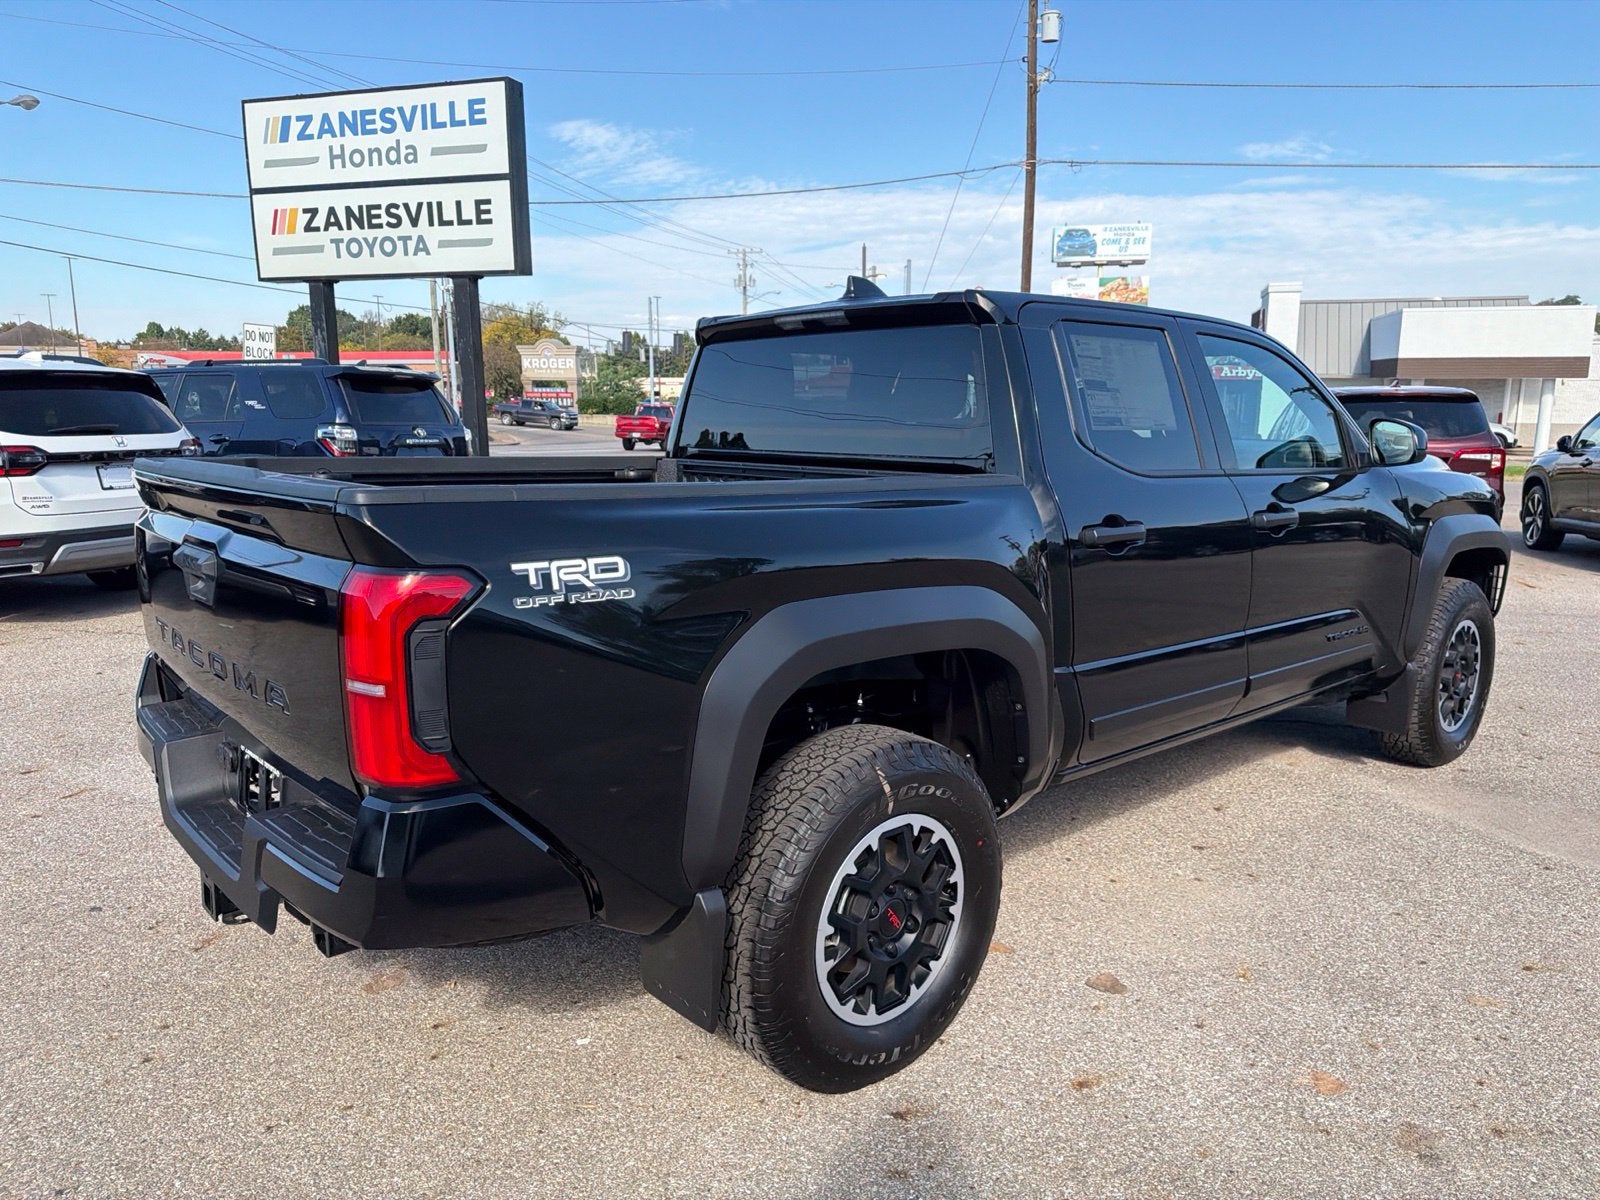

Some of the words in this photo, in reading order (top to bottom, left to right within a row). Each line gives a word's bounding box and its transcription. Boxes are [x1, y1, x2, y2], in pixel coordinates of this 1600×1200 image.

[296, 98, 487, 141] ZANESVILLE
[328, 139, 418, 170] Honda
[302, 198, 493, 233] ZANESVILLE
[330, 235, 431, 259] TOYOTA
[1101, 237, 1122, 246] COME
[1133, 236, 1146, 245] SEE
[1118, 245, 1129, 253] US
[245, 330, 256, 342] DO
[258, 331, 274, 344] NOT
[245, 345, 274, 359] BLOCK
[523, 358, 574, 369] KROGER
[510, 555, 631, 595] TRD
[512, 594, 565, 609] OFF
[568, 587, 636, 604] ROAD
[155, 616, 291, 716] TACOMA
[887, 907, 901, 929] TRD
